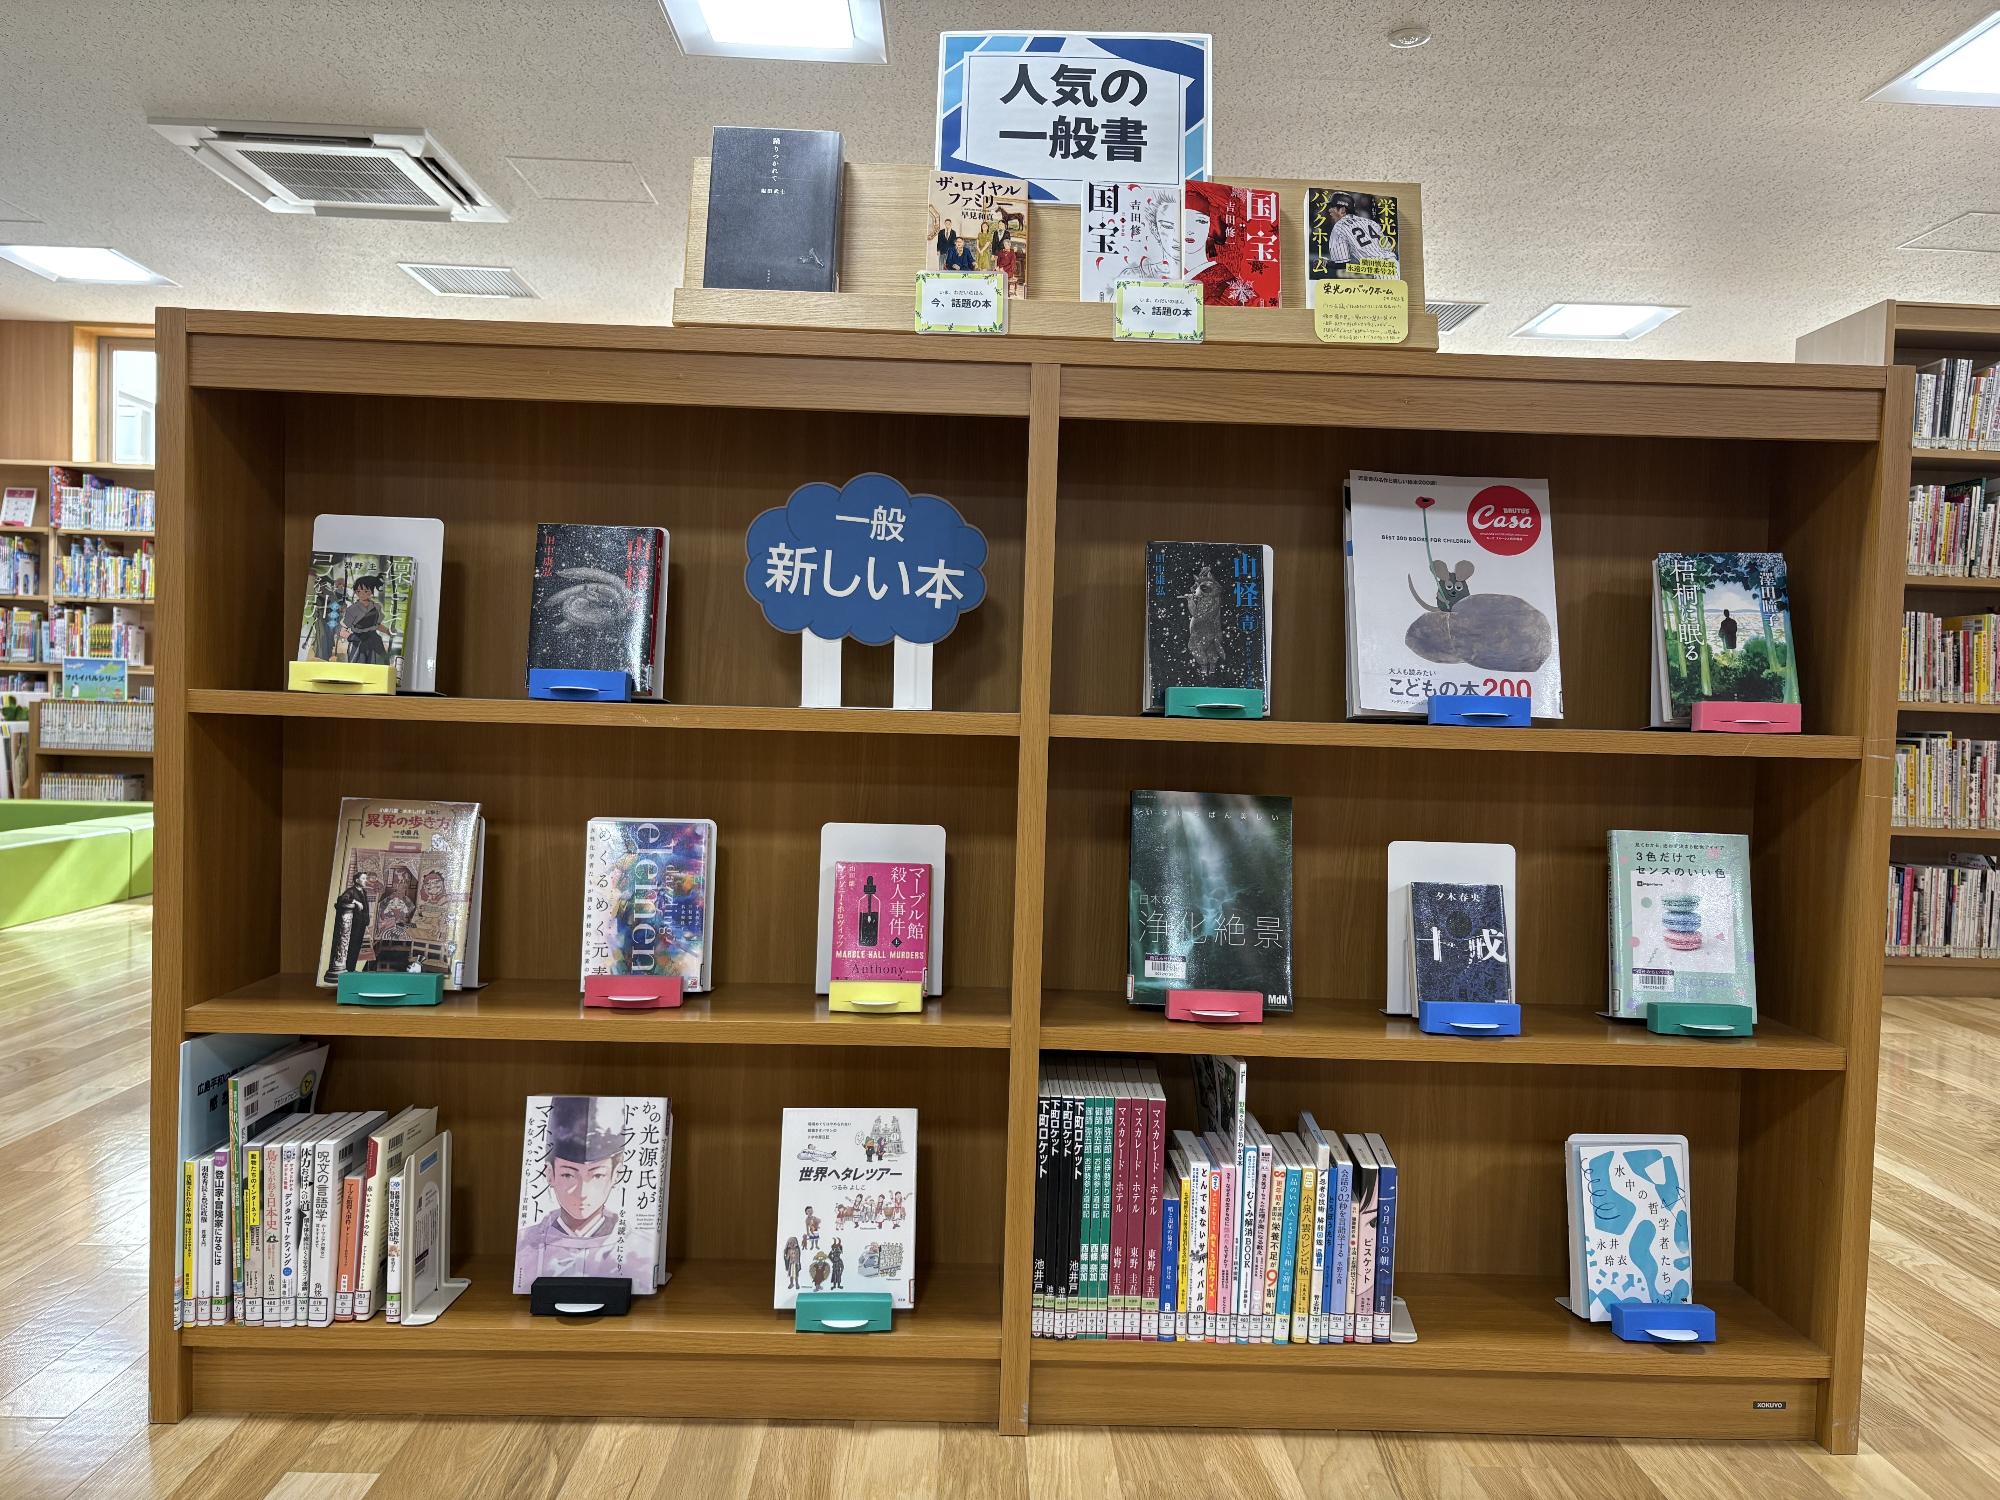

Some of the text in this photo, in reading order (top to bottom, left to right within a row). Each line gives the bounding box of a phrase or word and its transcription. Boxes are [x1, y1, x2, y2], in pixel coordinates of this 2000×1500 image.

[1000, 63, 1148, 106] 人気の
[999, 114, 1149, 163] 一般書
[936, 176, 1022, 196] ザ・ロイヤル
[948, 192, 1013, 209] ファミリー
[1087, 181, 1120, 255] 国宝
[1129, 199, 1142, 244] 吉田修一
[1246, 189, 1279, 263] 国宝
[1311, 191, 1329, 275] バックホーム
[1351, 224, 1382, 248] 24
[1378, 198, 1398, 250] 栄光の
[931, 297, 992, 309] 今、話題の本
[1131, 305, 1193, 318] 今、話題の本
[836, 505, 906, 543] 一般
[1473, 504, 1535, 530] Casa
[765, 542, 965, 609] 新しい本
[1233, 552, 1260, 608] 山怪
[65, 673, 125, 682] サバイバルシリーズ
[1389, 668, 1437, 677] 大人も読みたい
[1389, 678, 1533, 697] こどもの本200
[365, 813, 451, 831] 異界の歩き方
[1635, 866, 1726, 879] センスのいい色
[1636, 851, 1697, 863] 3色だけで
[888, 866, 907, 935] 殺人事件
[906, 866, 925, 940] マーブル館
[1139, 895, 1173, 906] 日本の
[1138, 910, 1285, 949] 浄化絶景
[835, 950, 924, 960] MARBLE HALL MURDERS
[851, 962, 906, 977] Anthony
[1268, 994, 1288, 1005] MdN
[525, 1118, 534, 1178] をなさったら
[1038, 1100, 1051, 1179] 下町ロケット
[1050, 1099, 1061, 1156] 下町ロケット
[1062, 1100, 1074, 1157] 下町ロケット
[1073, 1101, 1085, 1180] 下町ロケット
[530, 1104, 555, 1223] マネジメント
[636, 1101, 662, 1210] かの光源氏が
[799, 1166, 903, 1182] 世界ヘタレツアー
[1115, 1107, 1127, 1213] マスカレード・ホテル
[1132, 1107, 1143, 1214] マスカレード・ホテル
[1150, 1109, 1161, 1216] マスカレード・ホテル
[315, 1151, 330, 1221] 呪文の言語学
[616, 1104, 638, 1276] ドラッカーをお読みになり、
[214, 1170, 225, 1266] 登山家・冒険家になるには
[284, 1193, 293, 1267] デジタルマーケティング
[1243, 1190, 1255, 1269] むくみ解消BOOK
[1299, 1194, 1313, 1276] 小泉八雲のレシピ帖
[1380, 1205, 1390, 1274] 9月1日の朝へ
[1614, 1164, 1672, 1285] 水中の哲学者たち
[1265, 1221, 1281, 1298] 栄養不足が9割
[1363, 1237, 1374, 1285] ビスケット
[1596, 1238, 1620, 1251] 永井
[1604, 1254, 1628, 1267] 玲衣
[1033, 1258, 1045, 1293] 池井戸
[1068, 1260, 1079, 1295] 池井戸
